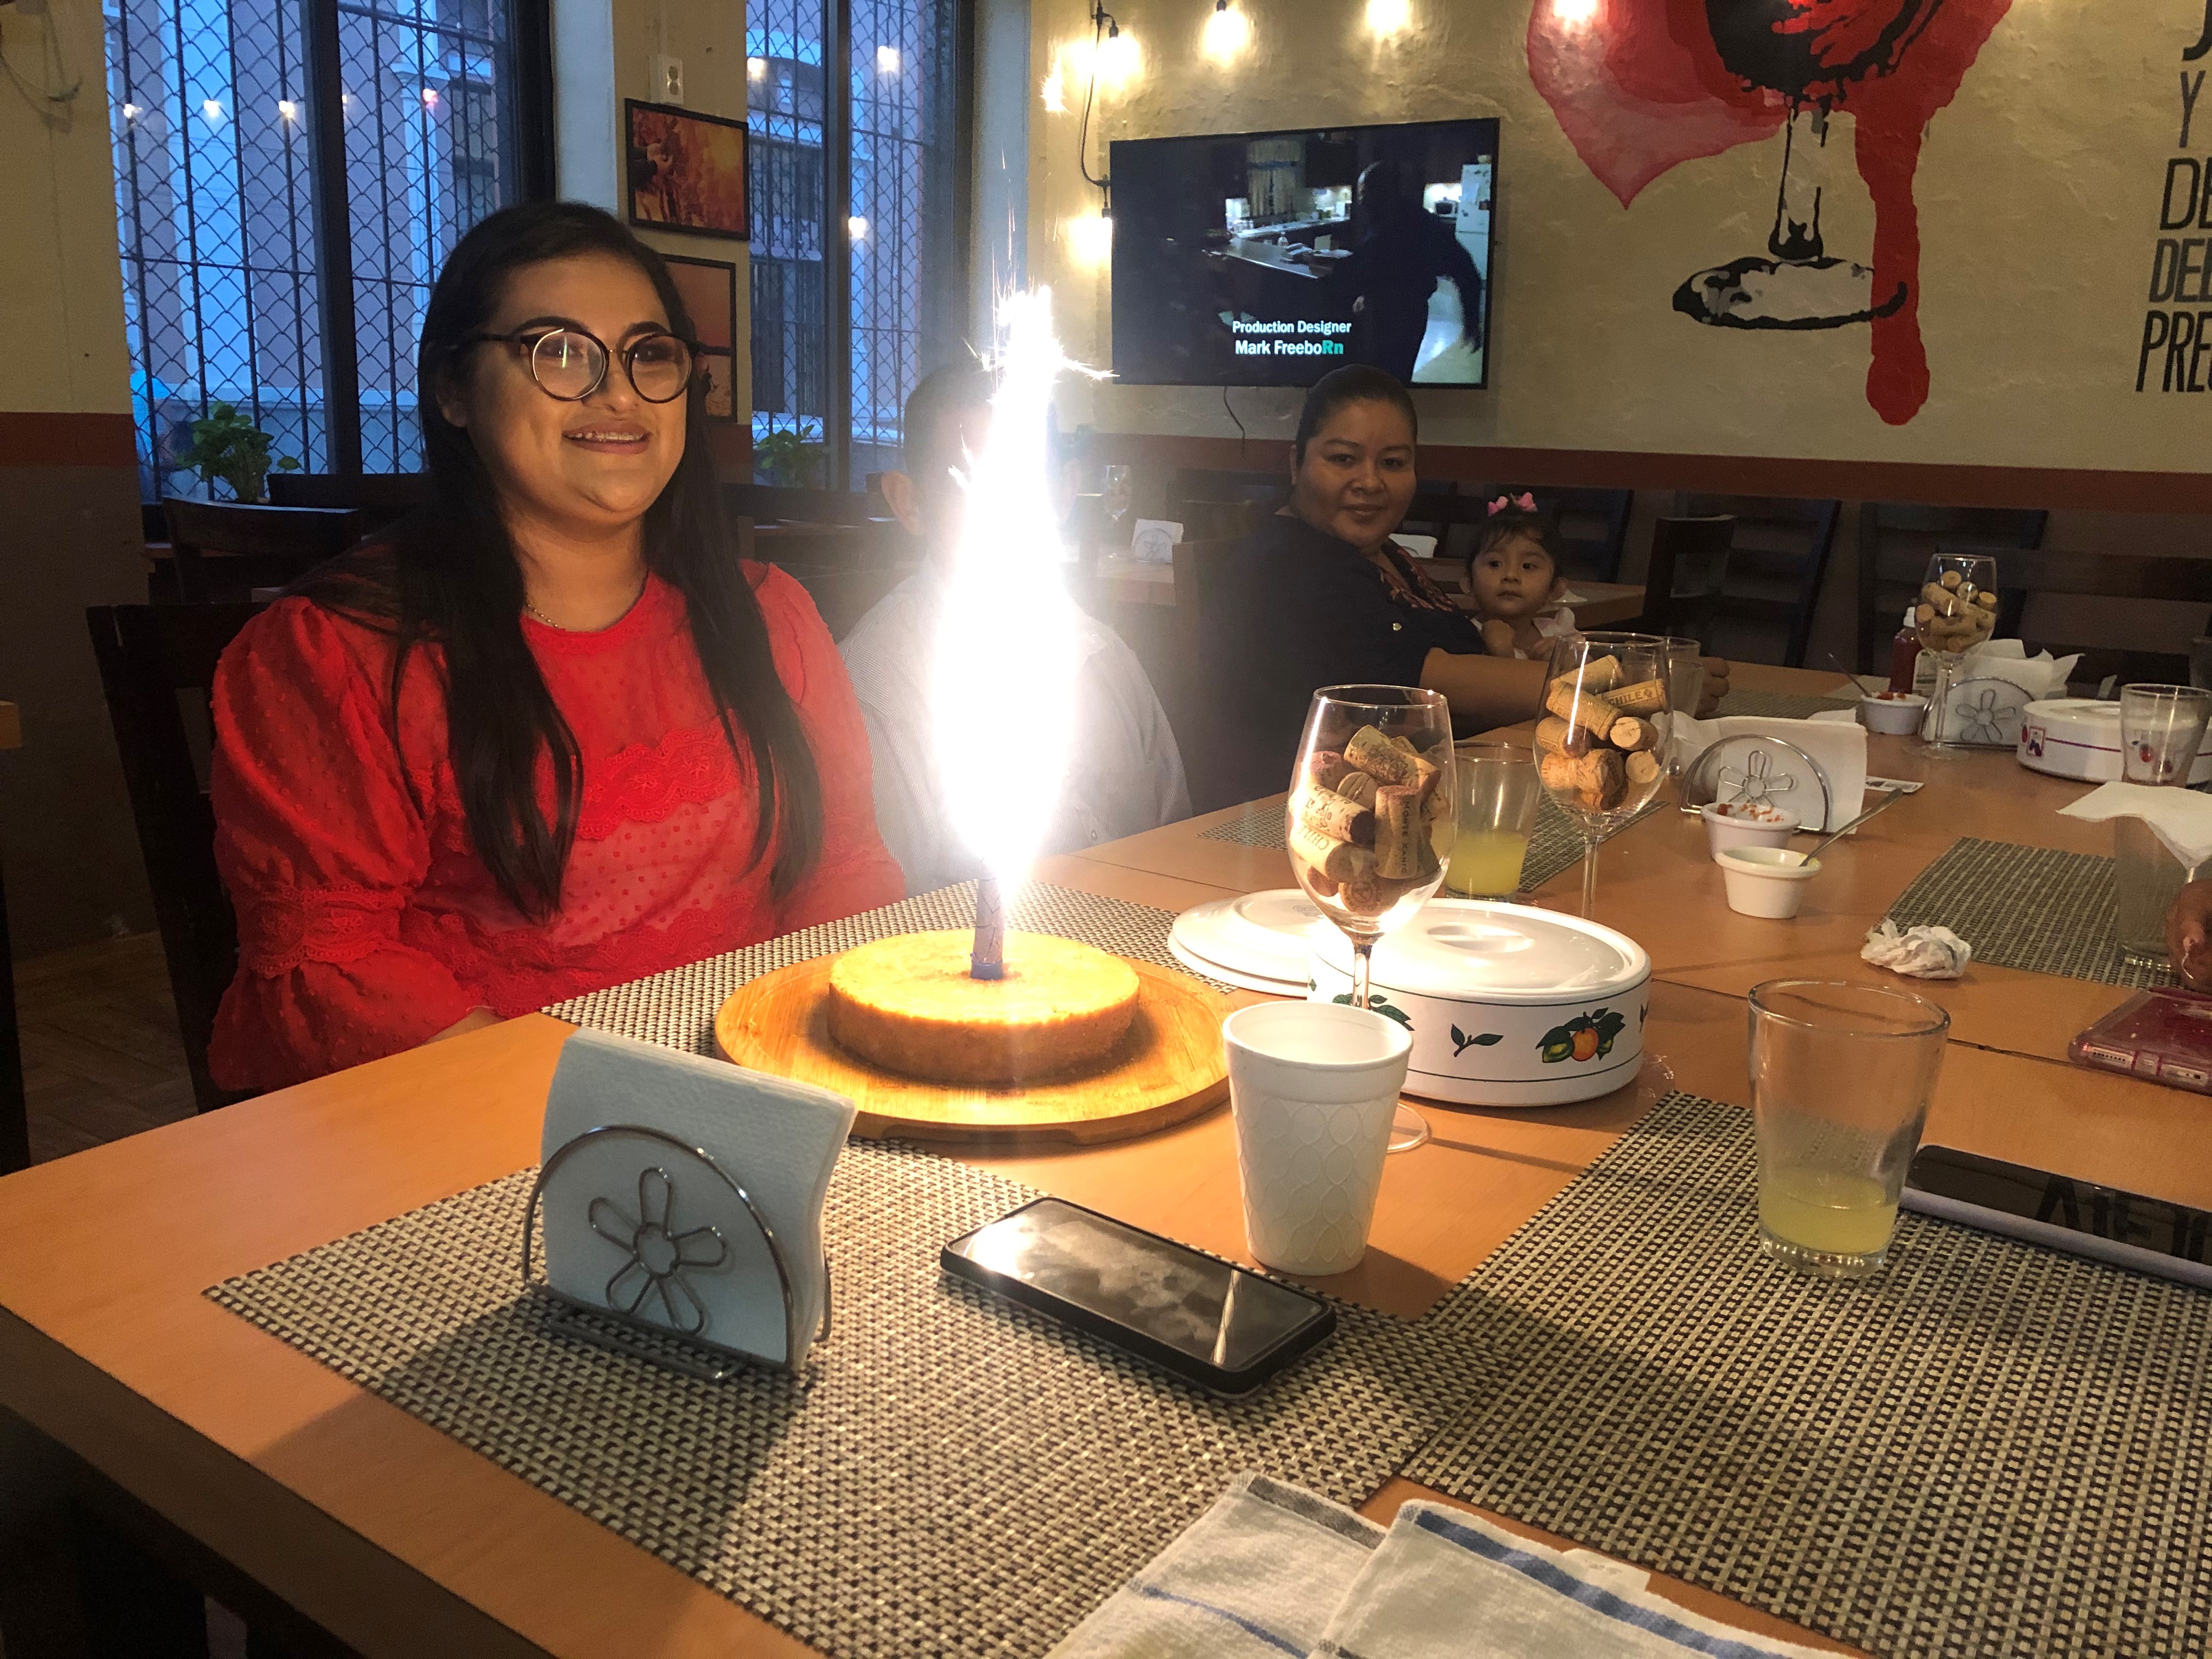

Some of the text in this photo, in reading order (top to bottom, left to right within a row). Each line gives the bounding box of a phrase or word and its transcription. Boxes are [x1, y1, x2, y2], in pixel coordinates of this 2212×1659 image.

[2179, 70, 2205, 148] Y
[1232, 320, 1352, 336] Production Designer
[1235, 340, 1344, 354] Mark FreeboRn
[2136, 310, 2212, 392] PRE
[1608, 691, 1643, 706] CHILE
